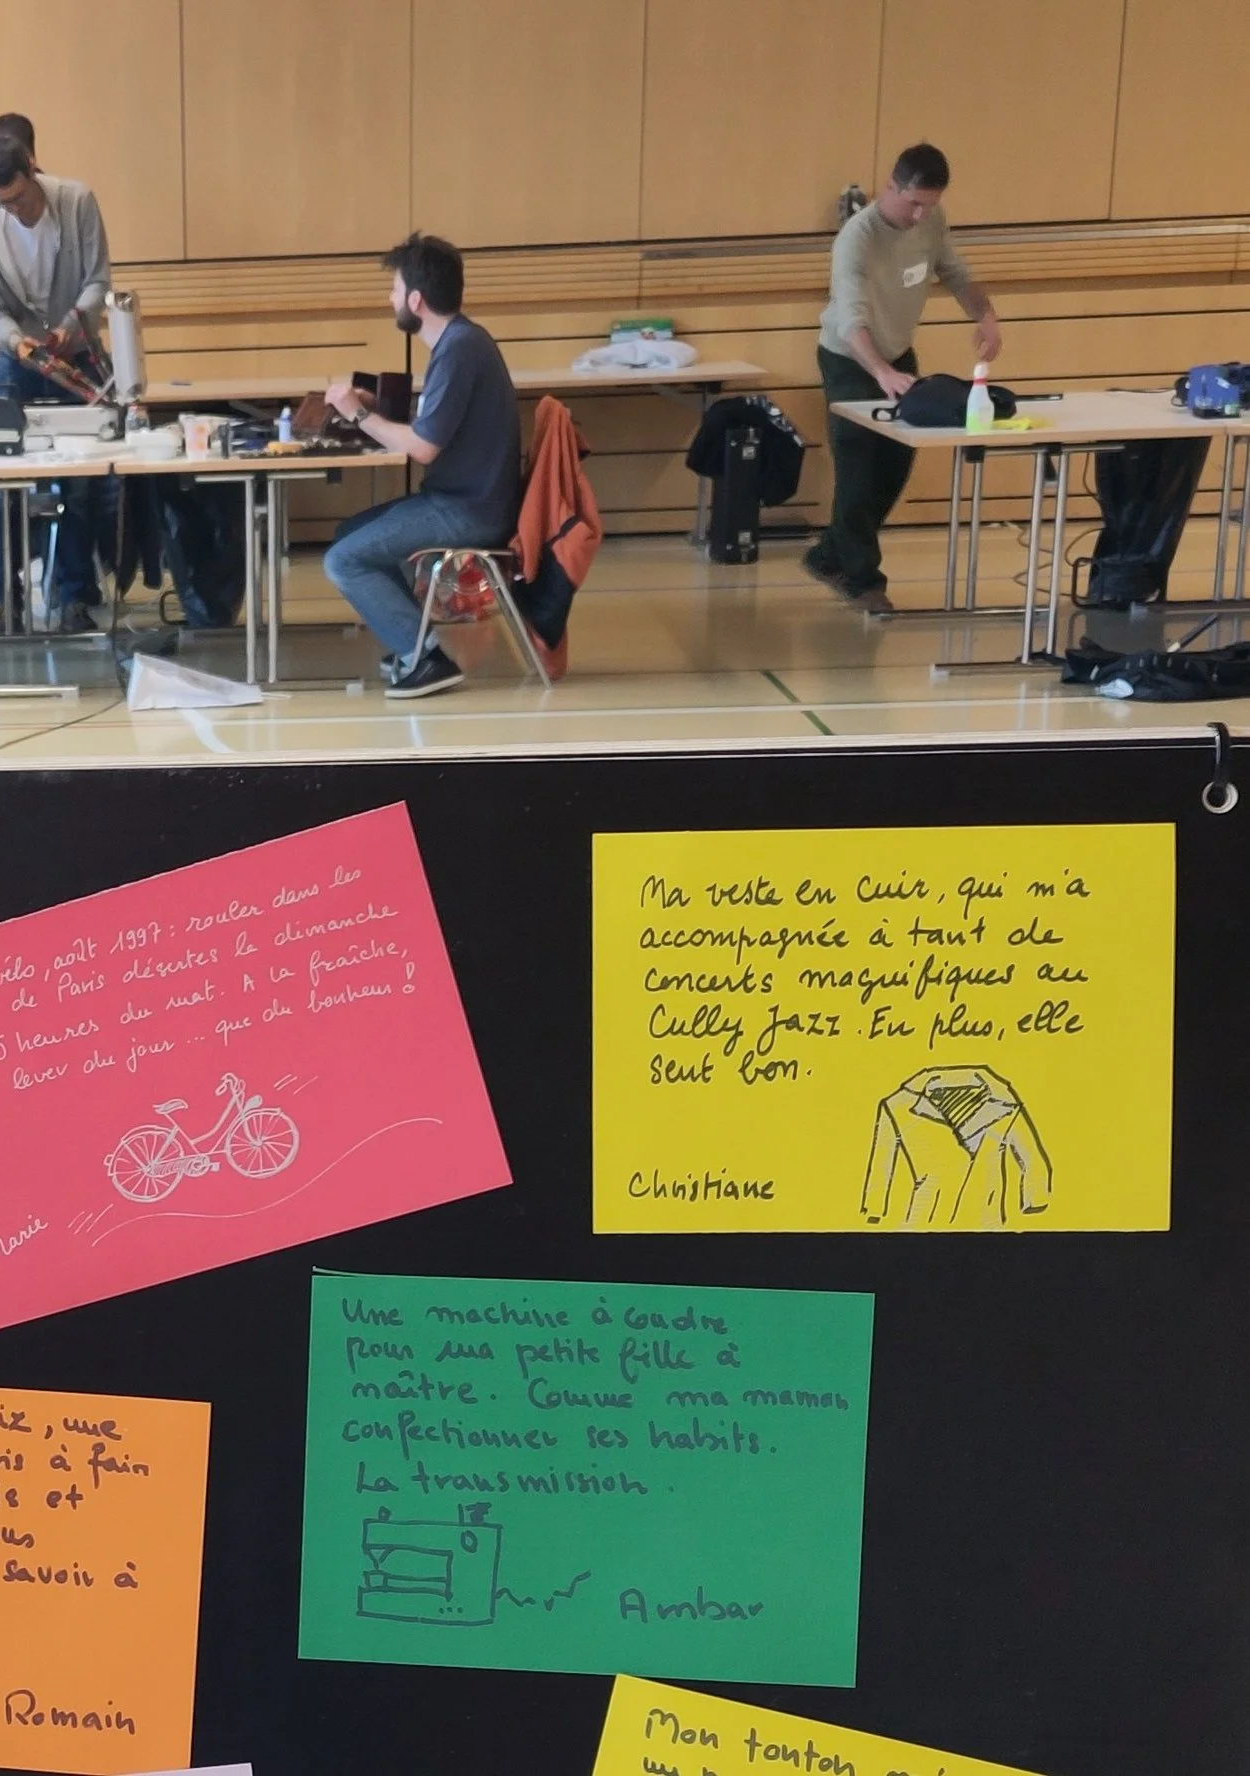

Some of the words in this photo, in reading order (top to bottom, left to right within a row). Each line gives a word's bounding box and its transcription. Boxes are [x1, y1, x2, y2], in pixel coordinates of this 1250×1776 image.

[185, 900, 264, 932] rouler
[272, 884, 319, 908] dans
[329, 865, 361, 889] les
[640, 874, 692, 910] Ma
[704, 875, 784, 908] veste
[794, 878, 837, 907] en
[957, 871, 1007, 921] qui
[11, 987, 38, 1012] de
[57, 972, 105, 1003] Paris
[122, 948, 218, 983] désertes
[234, 931, 258, 957] le
[274, 903, 399, 946] dimanche
[639, 917, 850, 966] accompagnée
[868, 918, 894, 948] à
[907, 915, 987, 947] tant
[1006, 916, 1065, 947] de
[644, 963, 774, 994] concerts
[798, 953, 1016, 1006] magnifiques
[1036, 962, 1090, 983] au
[12, 1064, 68, 1090] lever
[83, 1050, 116, 1074] du
[126, 1040, 175, 1073] jour
[214, 1017, 252, 1046] que
[262, 998, 293, 1023] du
[15, 1019, 100, 1052] heures
[120, 1002, 153, 1025] du
[648, 1003, 745, 1060] Cully
[867, 1005, 916, 1039] En
[1016, 999, 1085, 1035] elle
[628, 1167, 775, 1203] Christiane
[341, 1297, 405, 1327] Une
[425, 1297, 571, 1329] machine
[590, 1296, 614, 1326] à
[345, 1336, 415, 1377] pour
[434, 1339, 495, 1363] ma
[515, 1336, 600, 1381] petite
[617, 1336, 696, 1385] fille
[716, 1341, 742, 1369] à
[526, 1376, 635, 1411] Comme
[665, 1390, 730, 1408] ma
[742, 1388, 850, 1412] maman
[62, 1417, 123, 1441] une
[586, 1424, 629, 1450] ses
[49, 1443, 72, 1472] à
[355, 1460, 400, 1495] La
[45, 1483, 84, 1511] et
[2, 1559, 94, 1588] savoir
[113, 1561, 139, 1589] à
[4, 1689, 136, 1735] Romain
[645, 1708, 718, 1749] Mon
[744, 1727, 855, 1776] tonton
